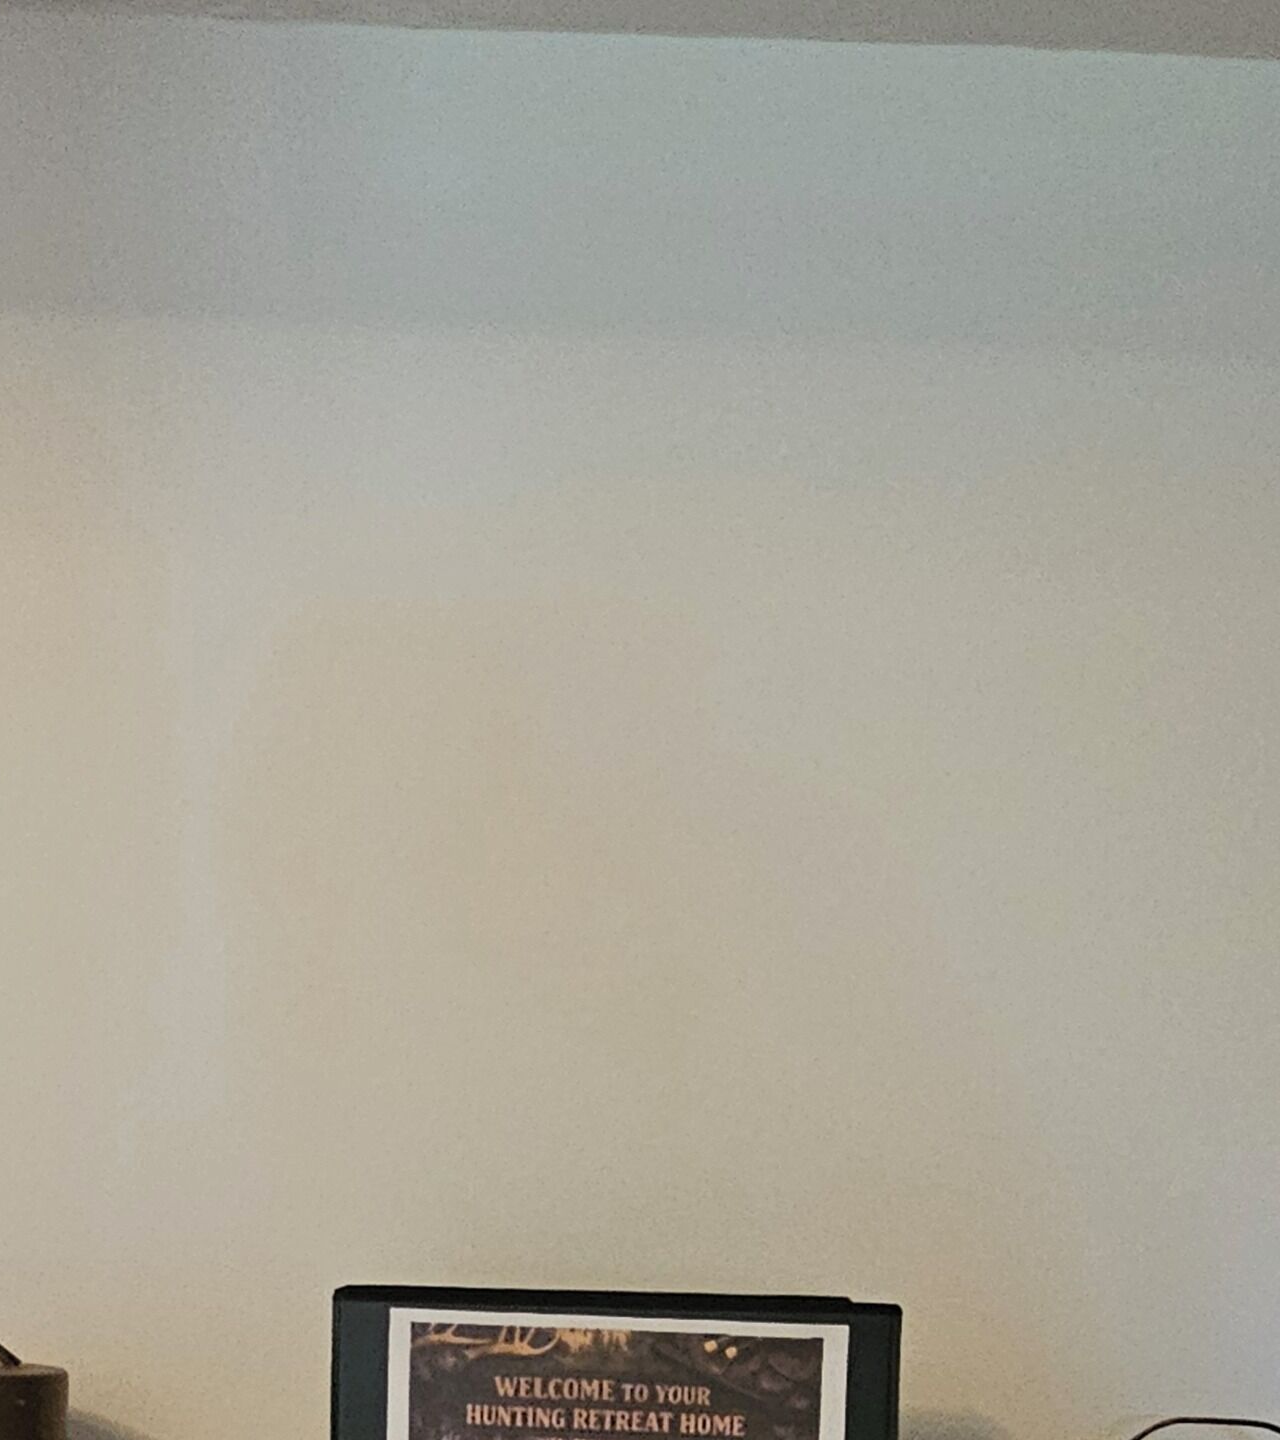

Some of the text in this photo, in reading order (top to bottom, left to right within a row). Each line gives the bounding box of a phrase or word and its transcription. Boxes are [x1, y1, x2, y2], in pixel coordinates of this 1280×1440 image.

[494, 1376, 711, 1406] WELCOME TO YOUR
[466, 1404, 746, 1437] HUNTING RETREAT HOME
